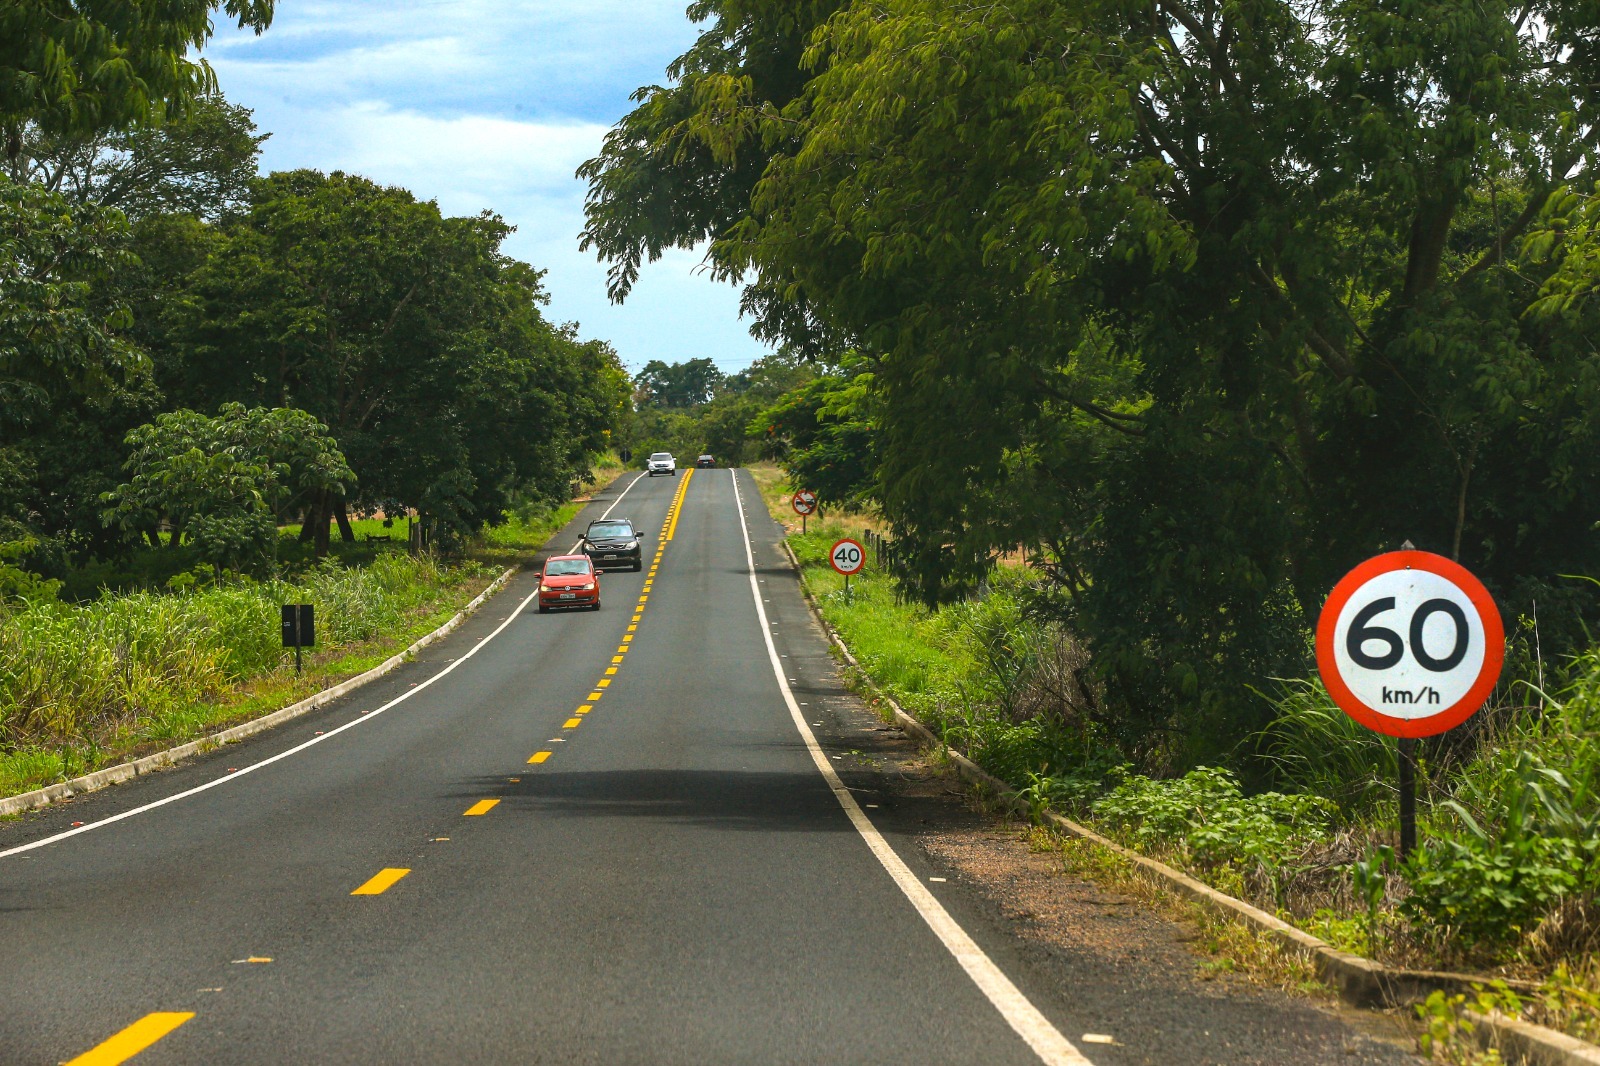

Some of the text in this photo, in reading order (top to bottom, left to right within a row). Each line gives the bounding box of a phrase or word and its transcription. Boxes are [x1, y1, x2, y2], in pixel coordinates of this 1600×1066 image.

[834, 548, 860, 563] 40
[1346, 596, 1470, 673] 60
[1382, 686, 1440, 704] km/h
